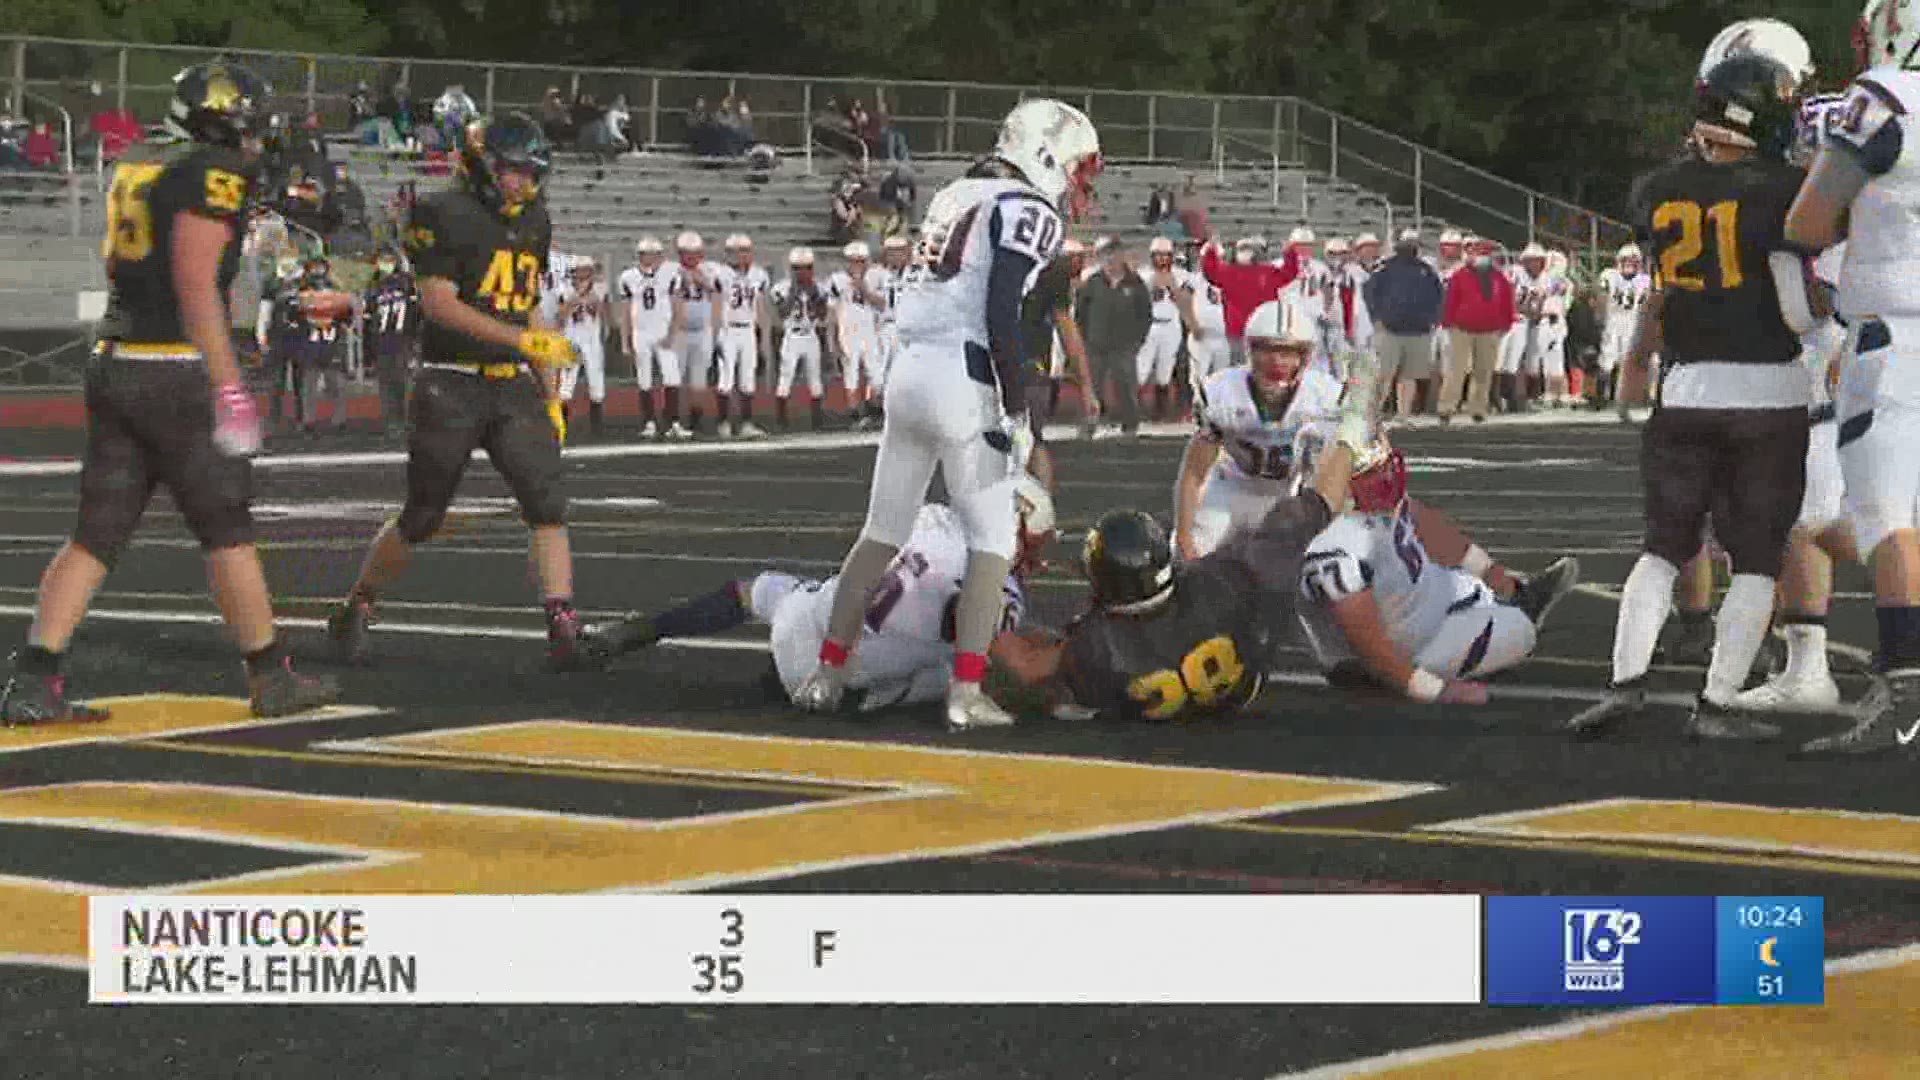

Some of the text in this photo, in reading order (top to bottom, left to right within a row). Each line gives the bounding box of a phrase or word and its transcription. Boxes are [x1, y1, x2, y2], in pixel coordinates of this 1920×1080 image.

[1013, 206, 1057, 258] 20
[1652, 200, 1743, 290] 21
[477, 249, 540, 311] 43
